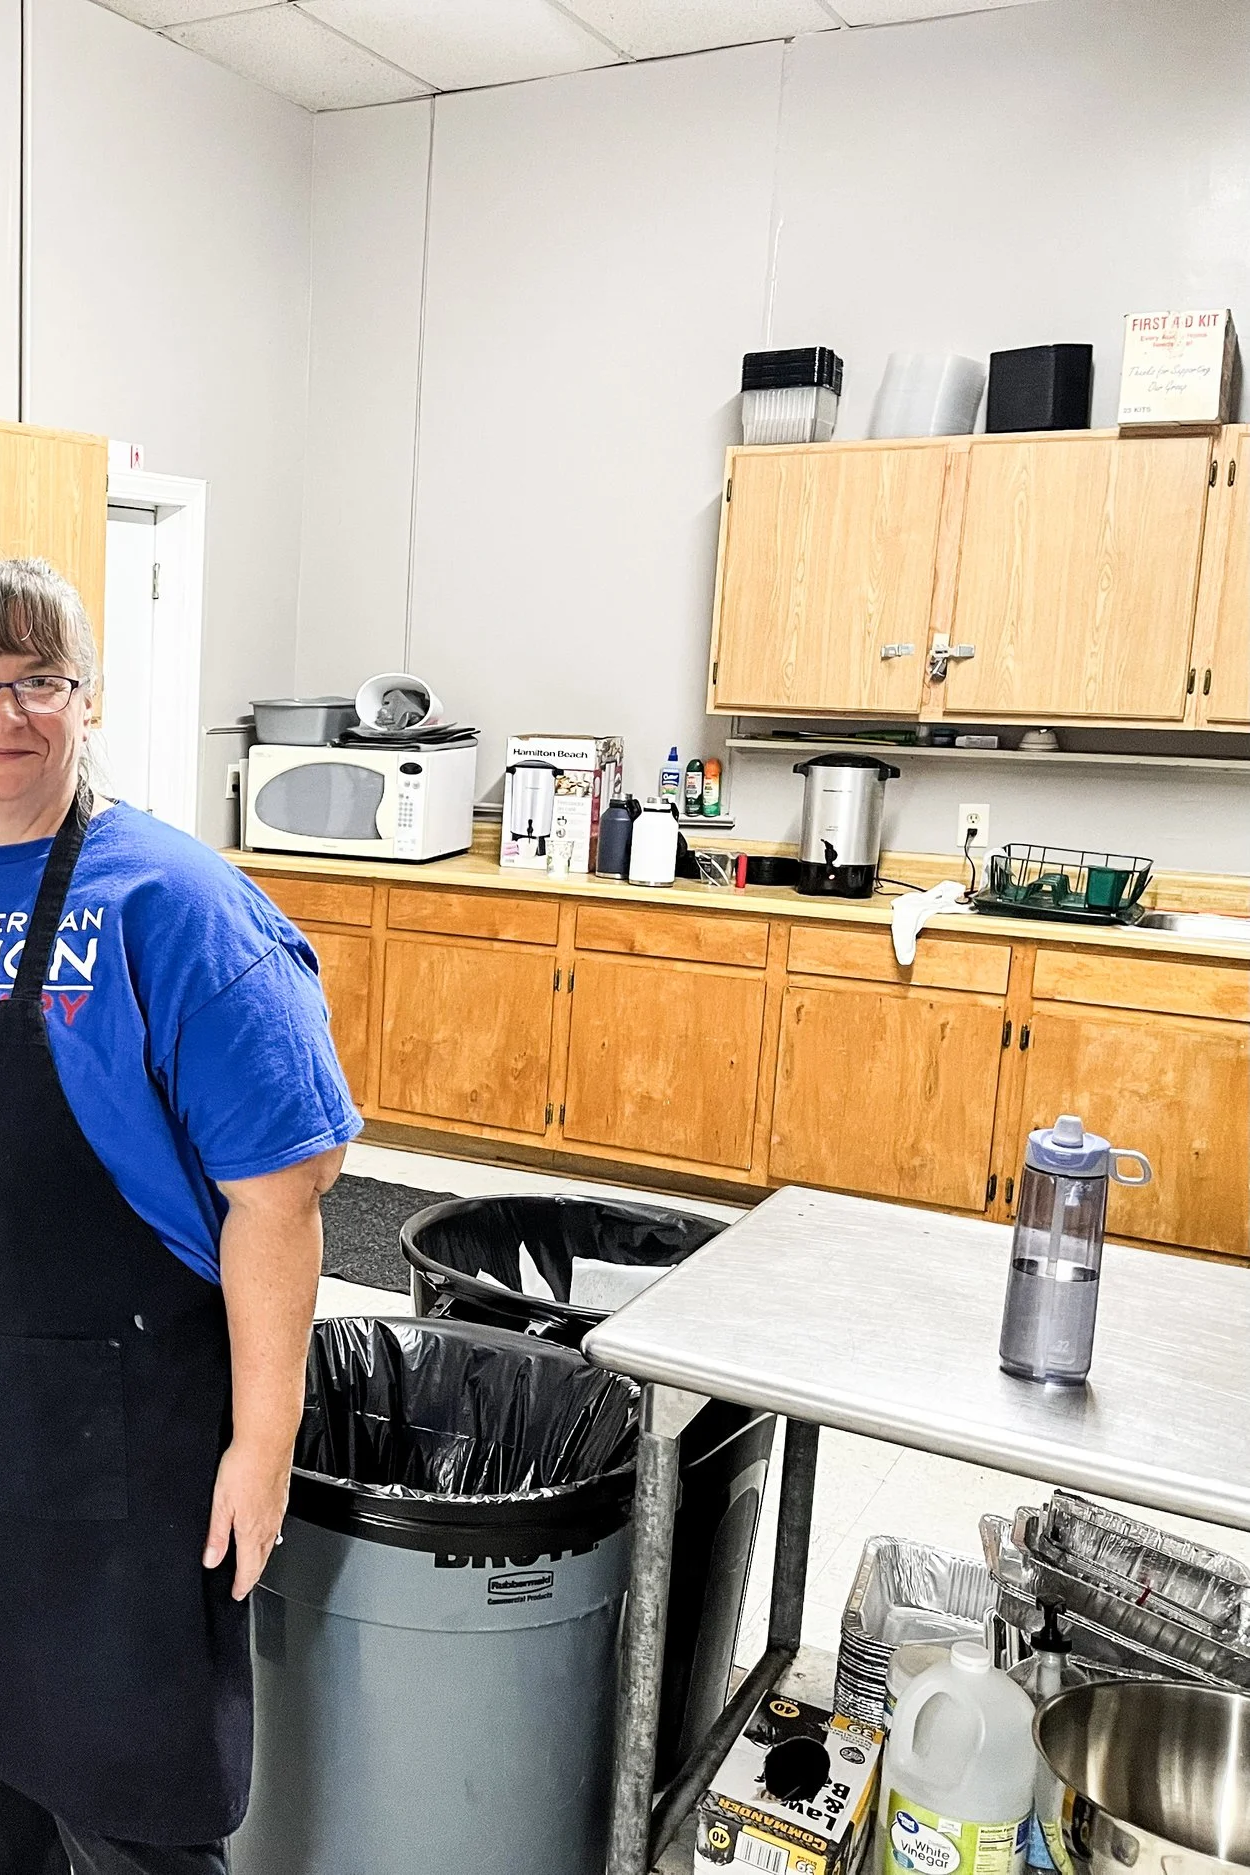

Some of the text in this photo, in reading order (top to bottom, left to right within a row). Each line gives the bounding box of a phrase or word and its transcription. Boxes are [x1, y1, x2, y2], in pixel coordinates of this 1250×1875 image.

[1132, 313, 1220, 331] FIRST AD KIT
[513, 748, 588, 759] Hamilton Beach
[491, 1575, 551, 1590] Rubbermaid
[487, 1591, 553, 1606] Commercial Products
[781, 1798, 838, 1832] Law
[717, 1797, 829, 1852] COMMANDER
[712, 1831, 728, 1845] 40
[901, 1840, 949, 1869] Vinegar
[915, 1839, 950, 1860] White
